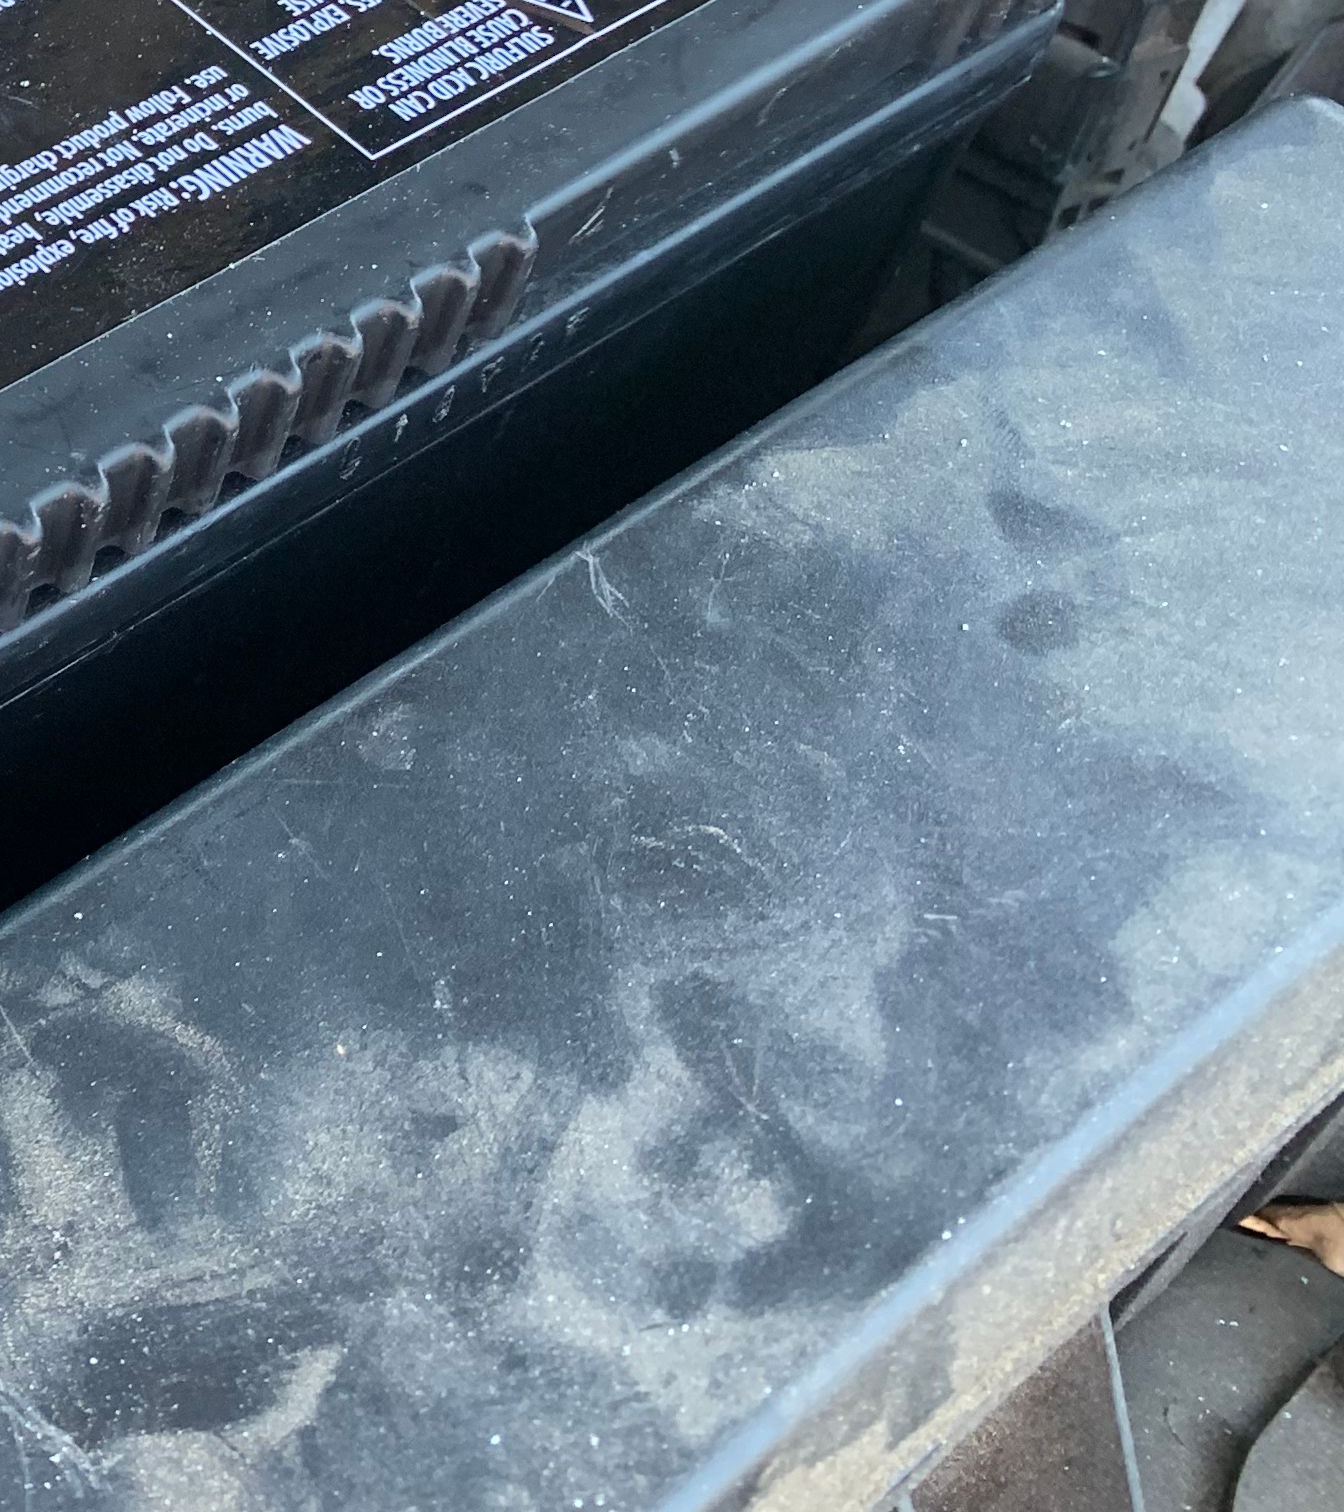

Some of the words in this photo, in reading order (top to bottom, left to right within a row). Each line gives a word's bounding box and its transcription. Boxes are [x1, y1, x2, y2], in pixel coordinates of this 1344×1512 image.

[248, 2, 351, 61] EXPLOSIVE
[370, 20, 449, 66] BURNS.
[464, 7, 534, 49] CAUSE
[374, 35, 480, 97] BLINDNESS
[463, 24, 556, 80] SULFURIC
[182, 64, 229, 91] use.
[221, 82, 250, 103] or
[424, 66, 478, 101] ACID
[123, 84, 193, 125] Follow
[346, 84, 388, 111] OR
[387, 89, 438, 122] CAN
[50, 110, 137, 161] product
[129, 92, 235, 148] incinerate.
[209, 99, 279, 138] burns.
[95, 139, 143, 169] Not
[145, 143, 191, 173] not
[180, 130, 220, 155] Do
[167, 122, 312, 203] WARNING:
[32, 160, 157, 229] disassemble,
[127, 186, 181, 219] Risk
[67, 216, 121, 247] fire,
[107, 206, 139, 233] of
